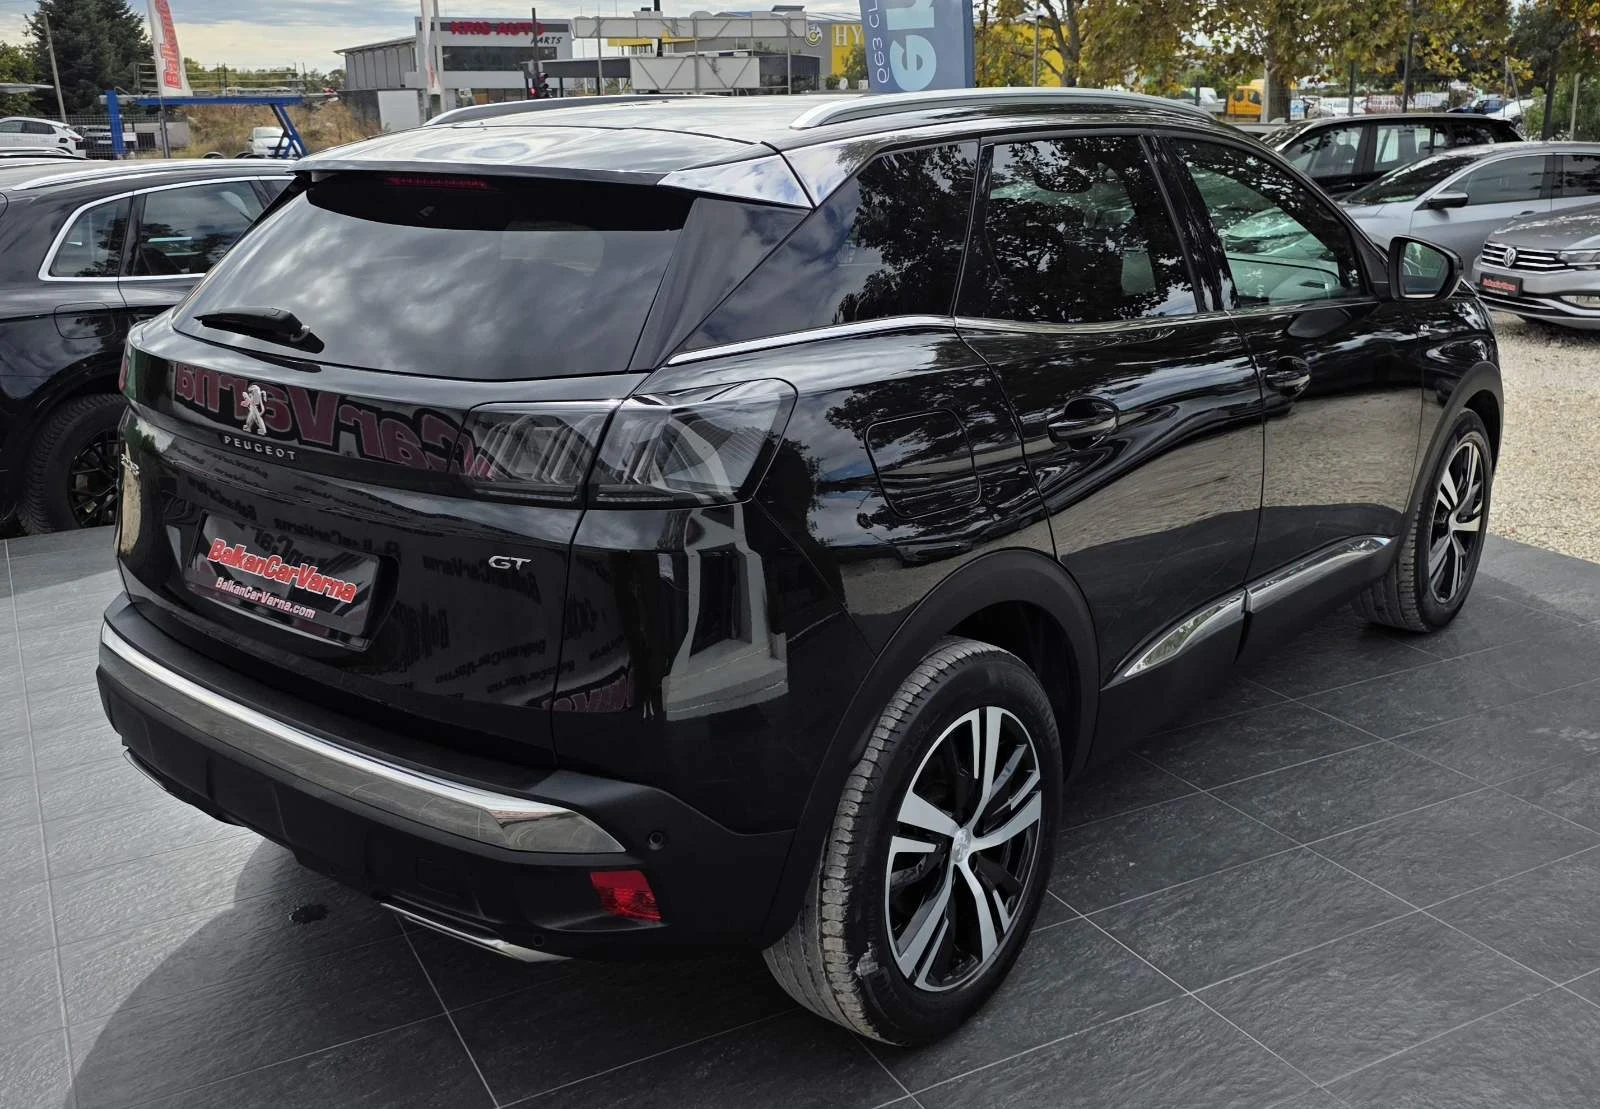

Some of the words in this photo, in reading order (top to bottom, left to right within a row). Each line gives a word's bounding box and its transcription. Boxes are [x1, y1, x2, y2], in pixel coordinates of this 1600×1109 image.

[223, 435, 296, 461] PEUGEOT
[207, 538, 357, 603] BalkanCarVarna
[488, 555, 531, 571] GT
[215, 577, 316, 619] BalkanCarVarna.com
